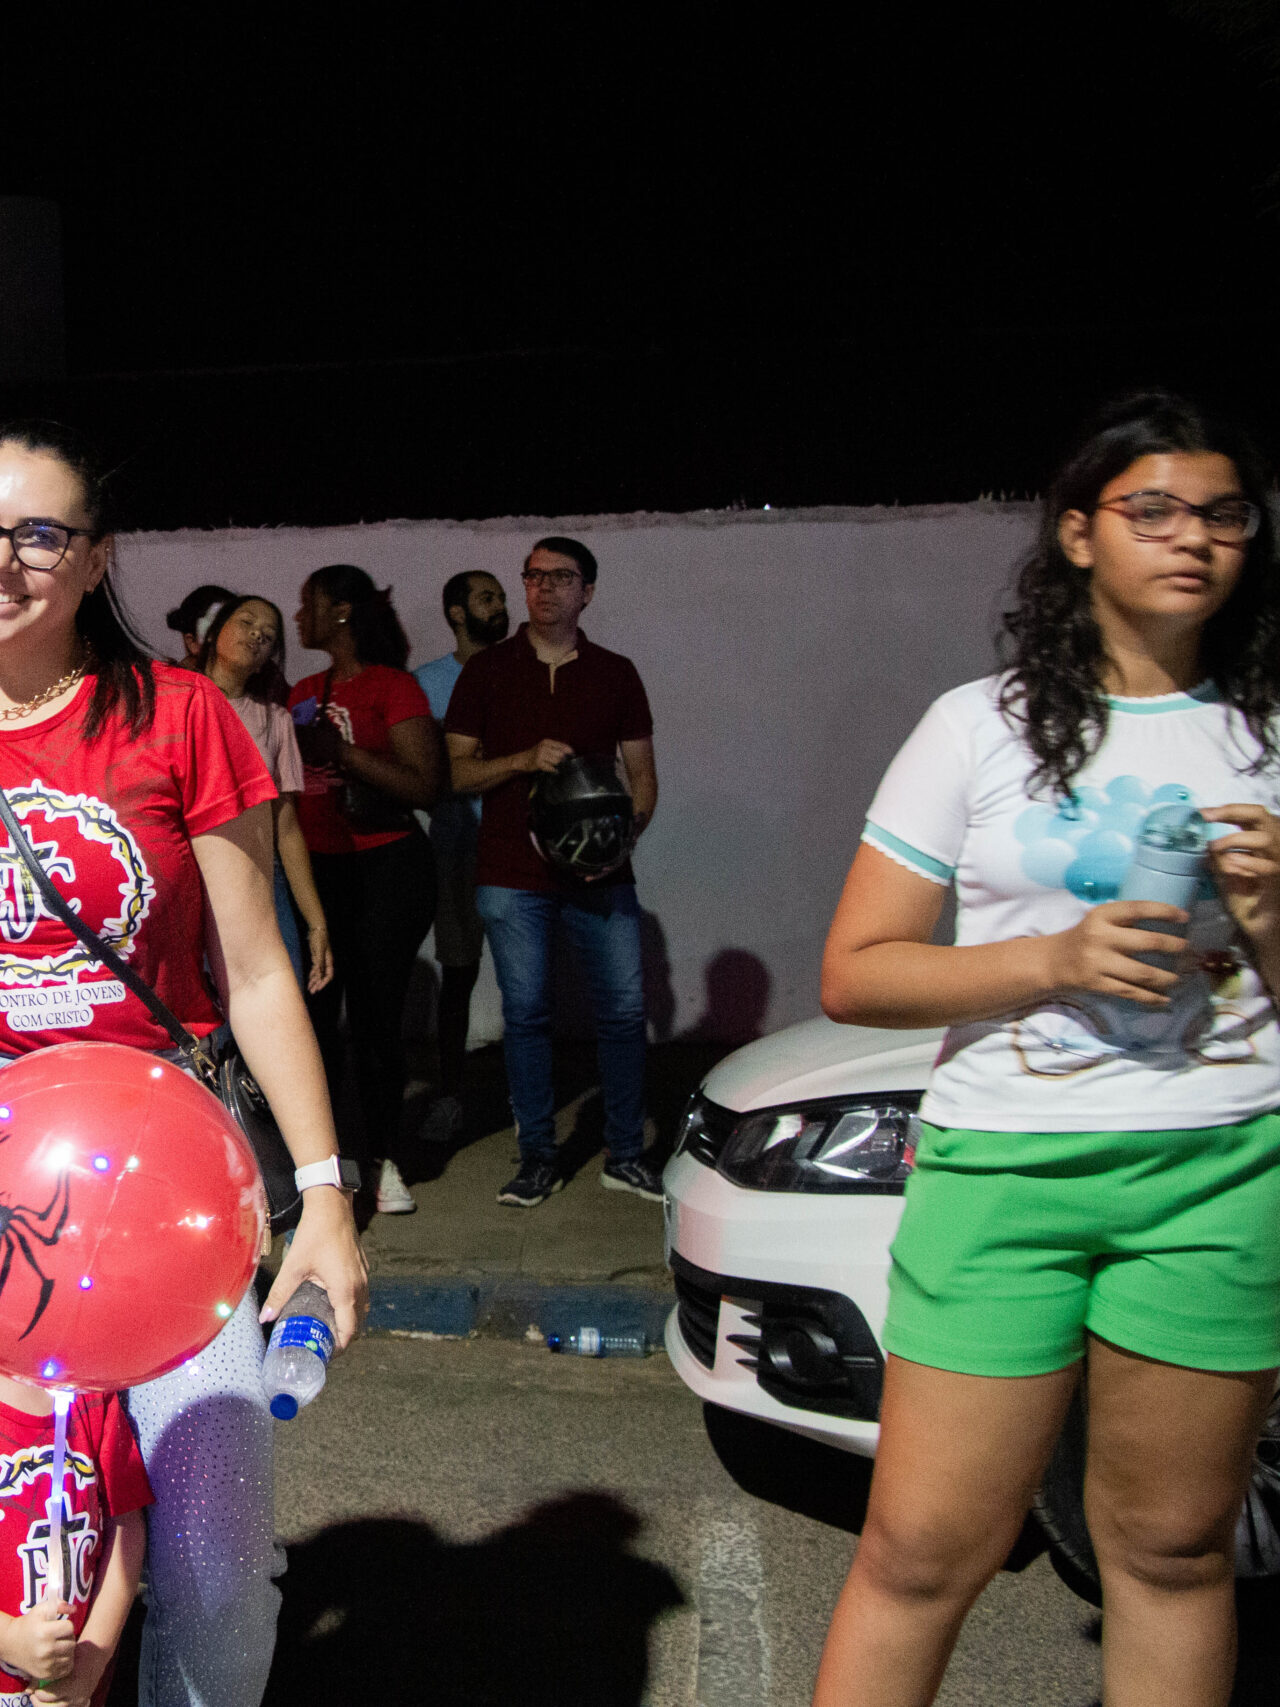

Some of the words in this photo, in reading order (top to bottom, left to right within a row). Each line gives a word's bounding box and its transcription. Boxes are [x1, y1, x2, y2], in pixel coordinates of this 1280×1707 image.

[53, 990, 73, 1005] DE
[75, 984, 123, 1006] JOVENS
[12, 1013, 43, 1028] COM
[46, 1009, 90, 1026] CRISTO
